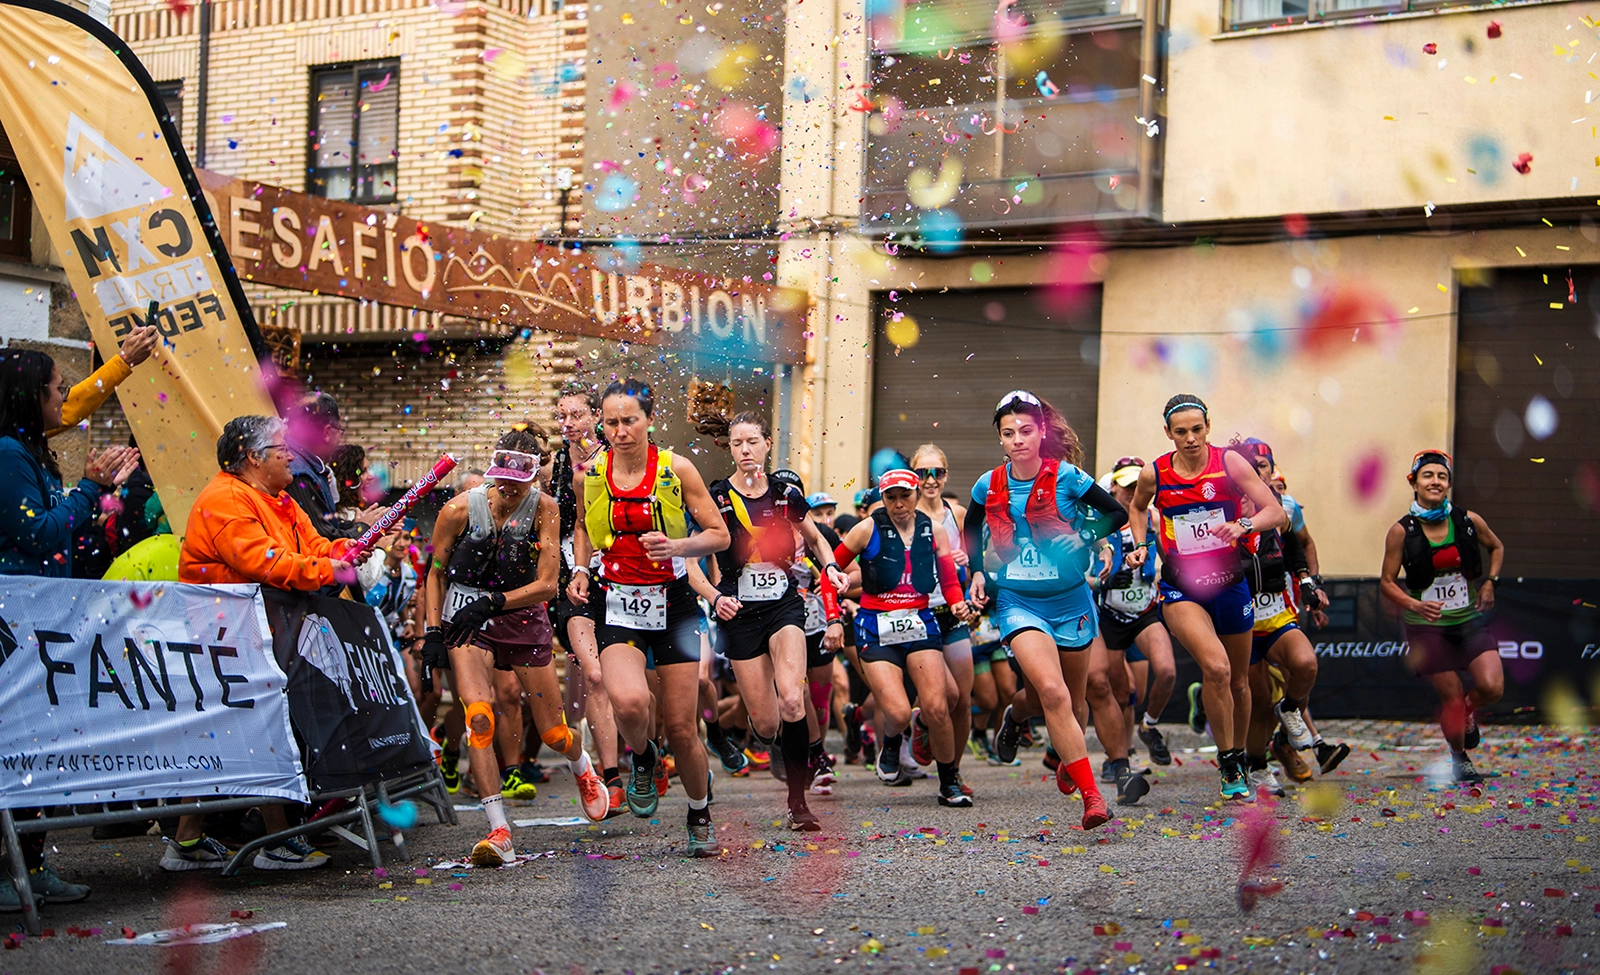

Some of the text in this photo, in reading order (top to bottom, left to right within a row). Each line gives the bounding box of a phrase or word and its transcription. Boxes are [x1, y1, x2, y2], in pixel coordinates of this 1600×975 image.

[204, 190, 767, 344] ESAFÍO URBIÓN
[1190, 522, 1210, 539] 161
[750, 572, 777, 587] 135
[1121, 588, 1144, 602] 103
[1435, 585, 1456, 599] 116
[620, 598, 651, 614] 149
[889, 619, 914, 633] 152
[34, 627, 255, 711] FANTÉ
